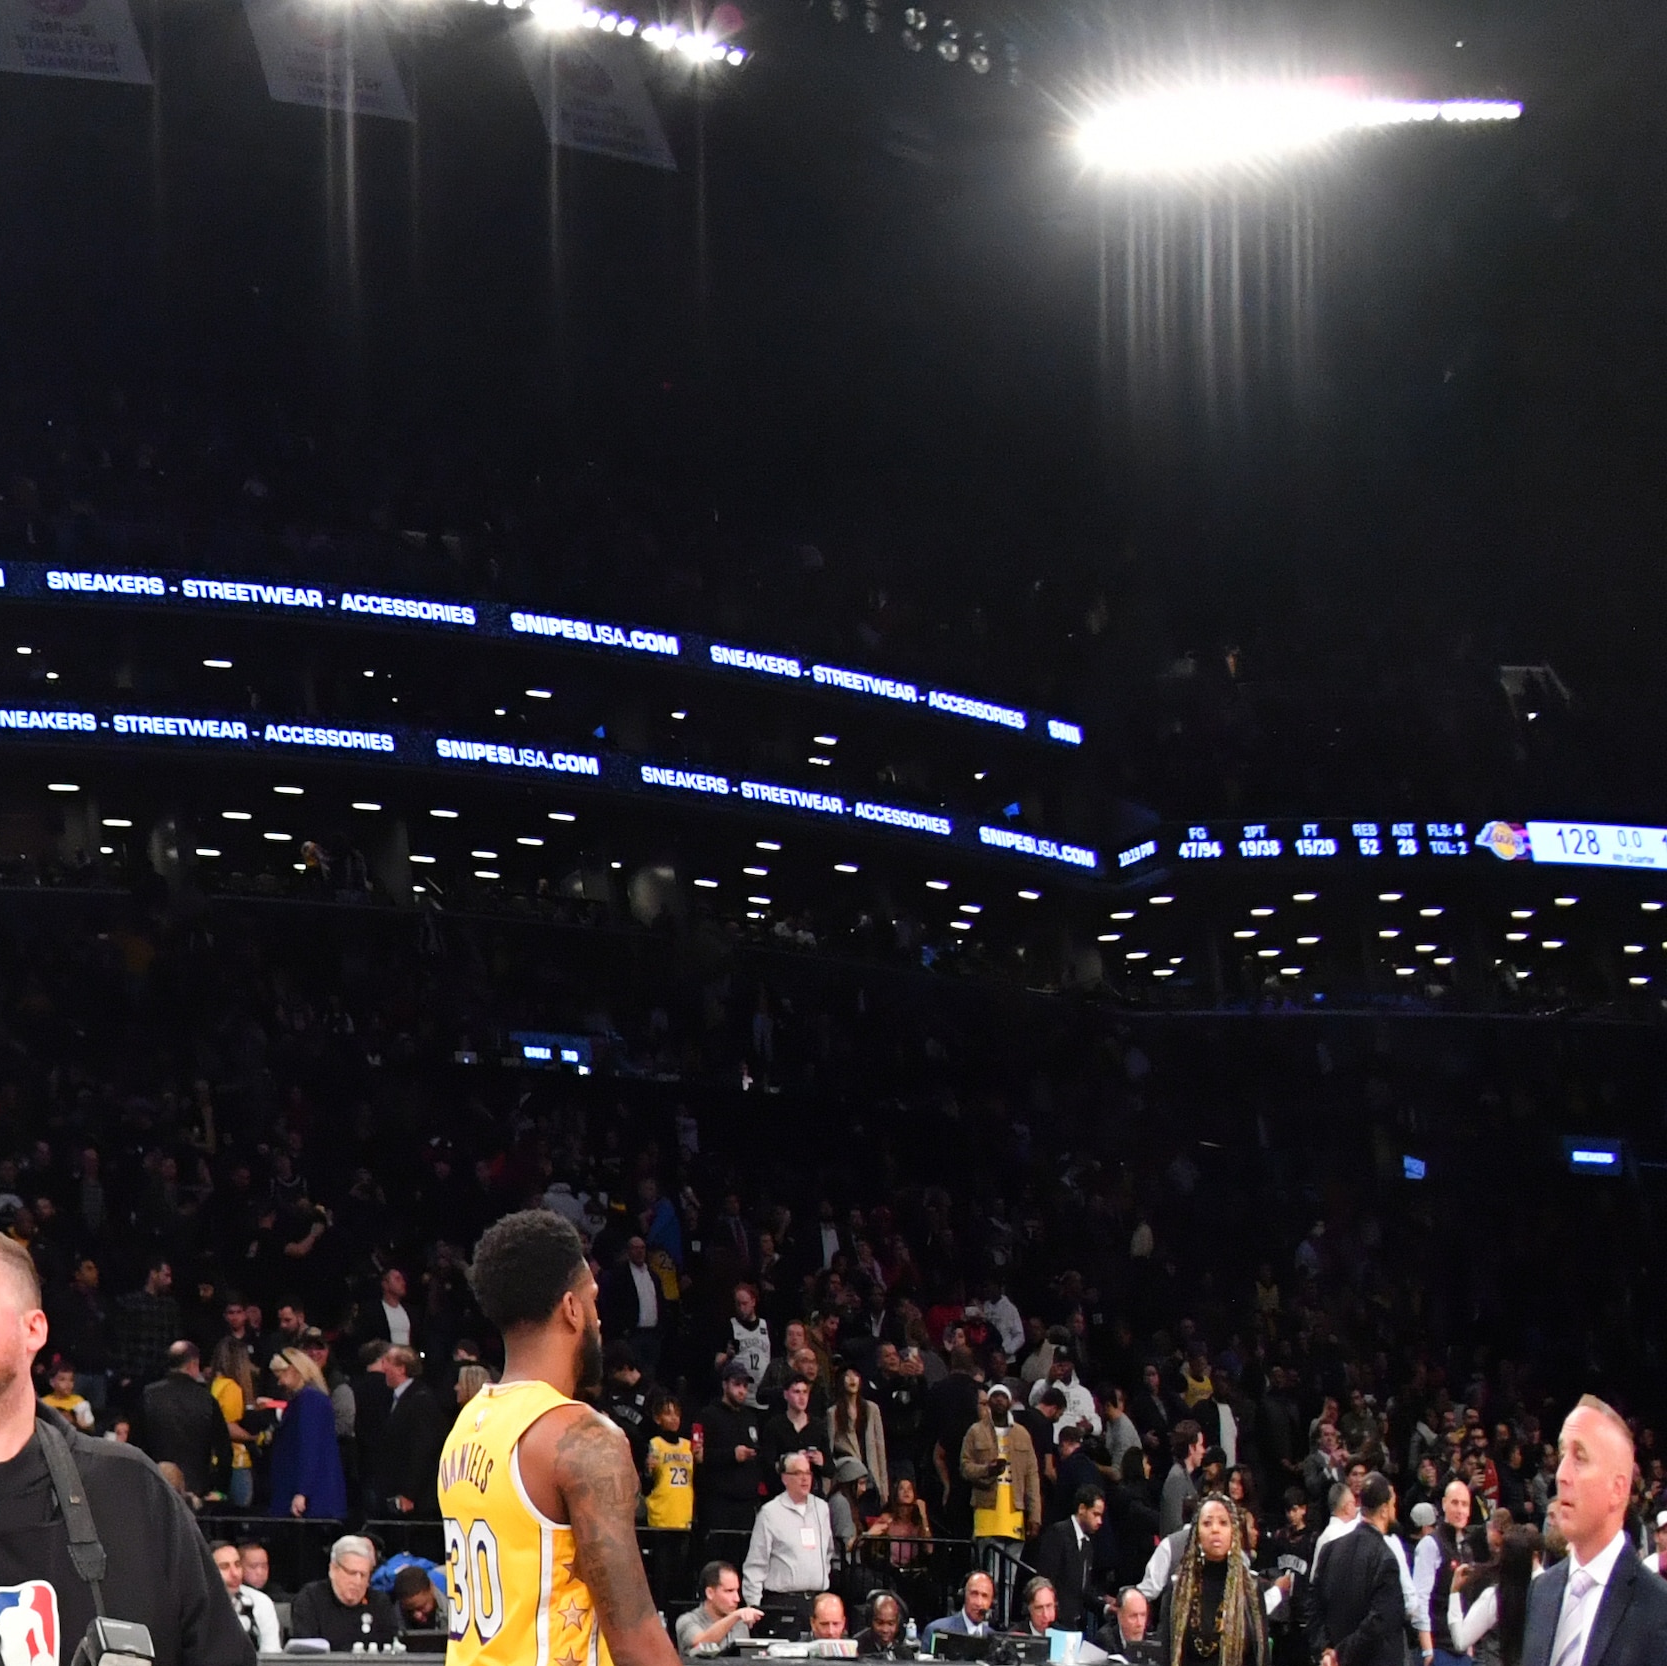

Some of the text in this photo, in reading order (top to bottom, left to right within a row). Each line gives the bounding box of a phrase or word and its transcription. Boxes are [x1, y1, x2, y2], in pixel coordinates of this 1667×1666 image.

[46, 570, 166, 596] SNEAKERS
[181, 578, 324, 609] STREETWEAR
[340, 592, 477, 626] ACCESSORIES
[509, 611, 681, 656] SNIPESUSA.COM
[709, 644, 803, 678] SNEAKERS
[814, 665, 917, 703] STREETWEAR
[927, 690, 1028, 730] ACCESSORIES
[112, 714, 248, 740] STREETWEAR
[264, 723, 395, 752] ACCESSORIES
[435, 738, 600, 776] SNIPESUSA.COM
[640, 765, 730, 795] SNEAKERS
[742, 780, 842, 814] STREETWEAR
[854, 801, 953, 836] ACCESSORIES
[1188, 826, 1208, 841] FG
[1243, 824, 1266, 839] 3PT
[1302, 823, 1319, 837] FT
[1352, 823, 1379, 837] REB
[1391, 823, 1414, 837] AST
[1426, 823, 1465, 838] FLS: 4
[1618, 830, 1642, 848] 0.0
[978, 825, 1098, 869] SNIPESUSA.COM
[1178, 841, 1223, 859] 47/94
[1238, 839, 1283, 857] 19/38
[1295, 838, 1337, 856] 15/20
[1359, 837, 1381, 856] 52
[1396, 838, 1419, 856] 28
[1457, 841, 1469, 855] 2
[1556, 828, 1600, 855] 128
[749, 1353, 760, 1370] 12
[441, 1442, 494, 1494] DANIELS
[670, 1467, 688, 1485] 23
[443, 1517, 503, 1646] 30
